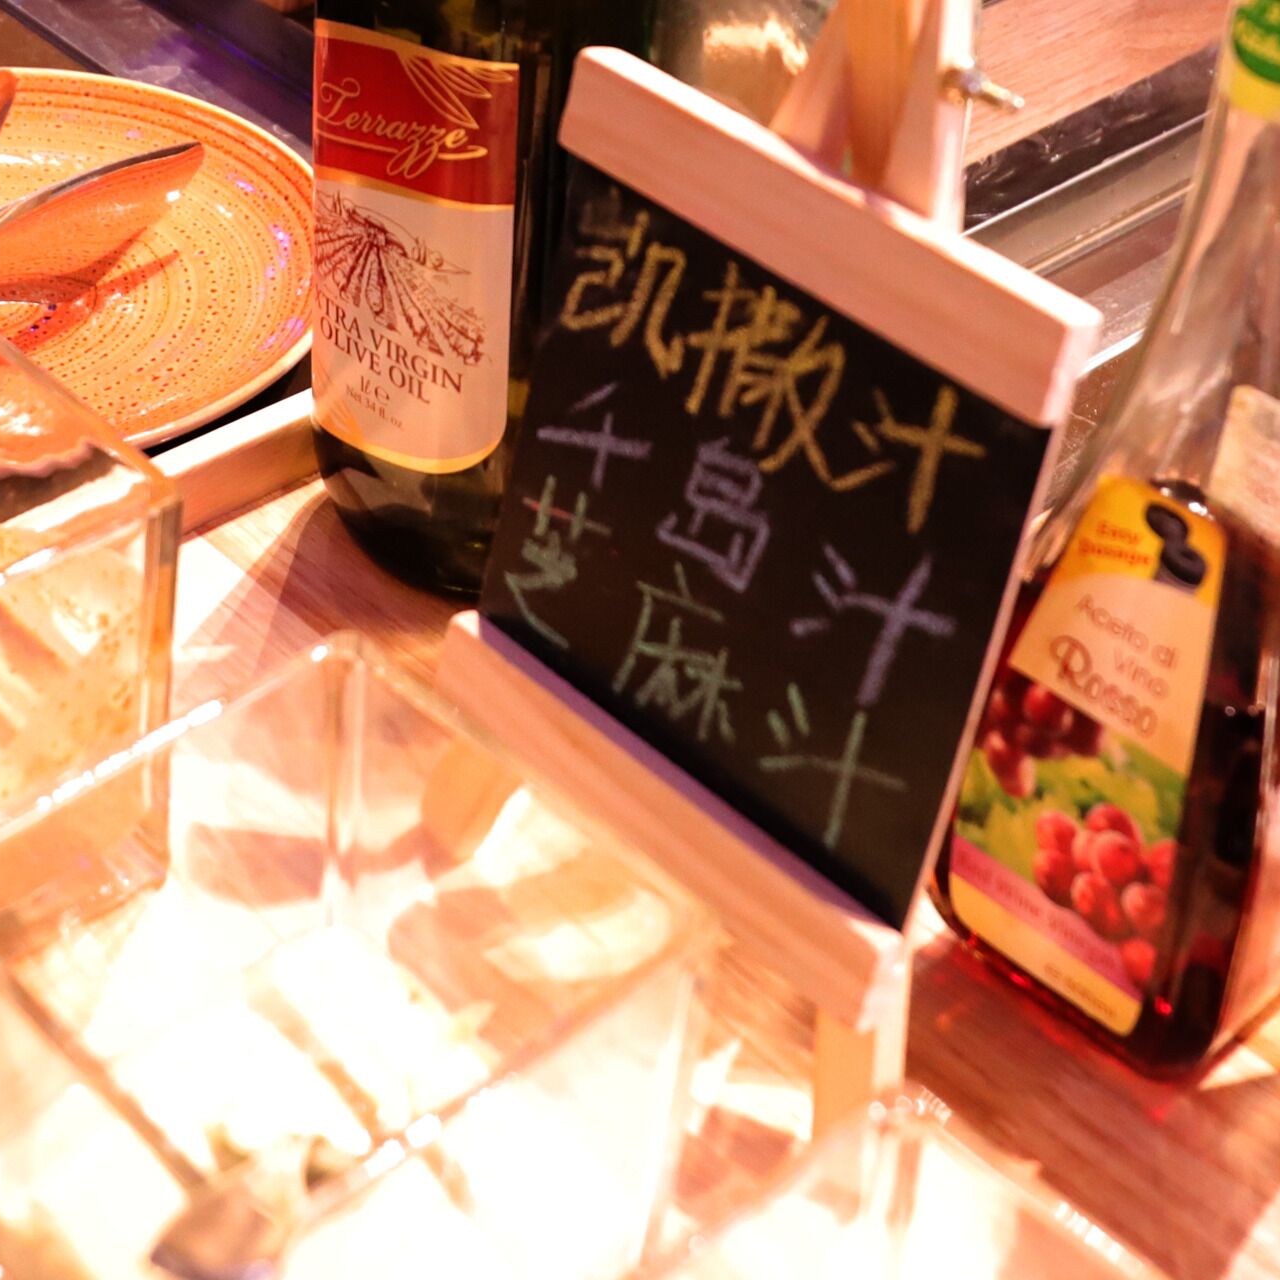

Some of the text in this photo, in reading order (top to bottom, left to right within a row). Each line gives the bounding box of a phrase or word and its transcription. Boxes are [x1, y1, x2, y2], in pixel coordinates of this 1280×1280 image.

[319, 77, 469, 180] Terrazze
[320, 315, 431, 404] OLIVE OIL
[369, 327, 463, 394] VIRGIN
[365, 398, 377, 413] 34
[1075, 593, 1149, 652] Aceto
[1048, 634, 1159, 738] Rosso
[1113, 646, 1170, 700] Vino
